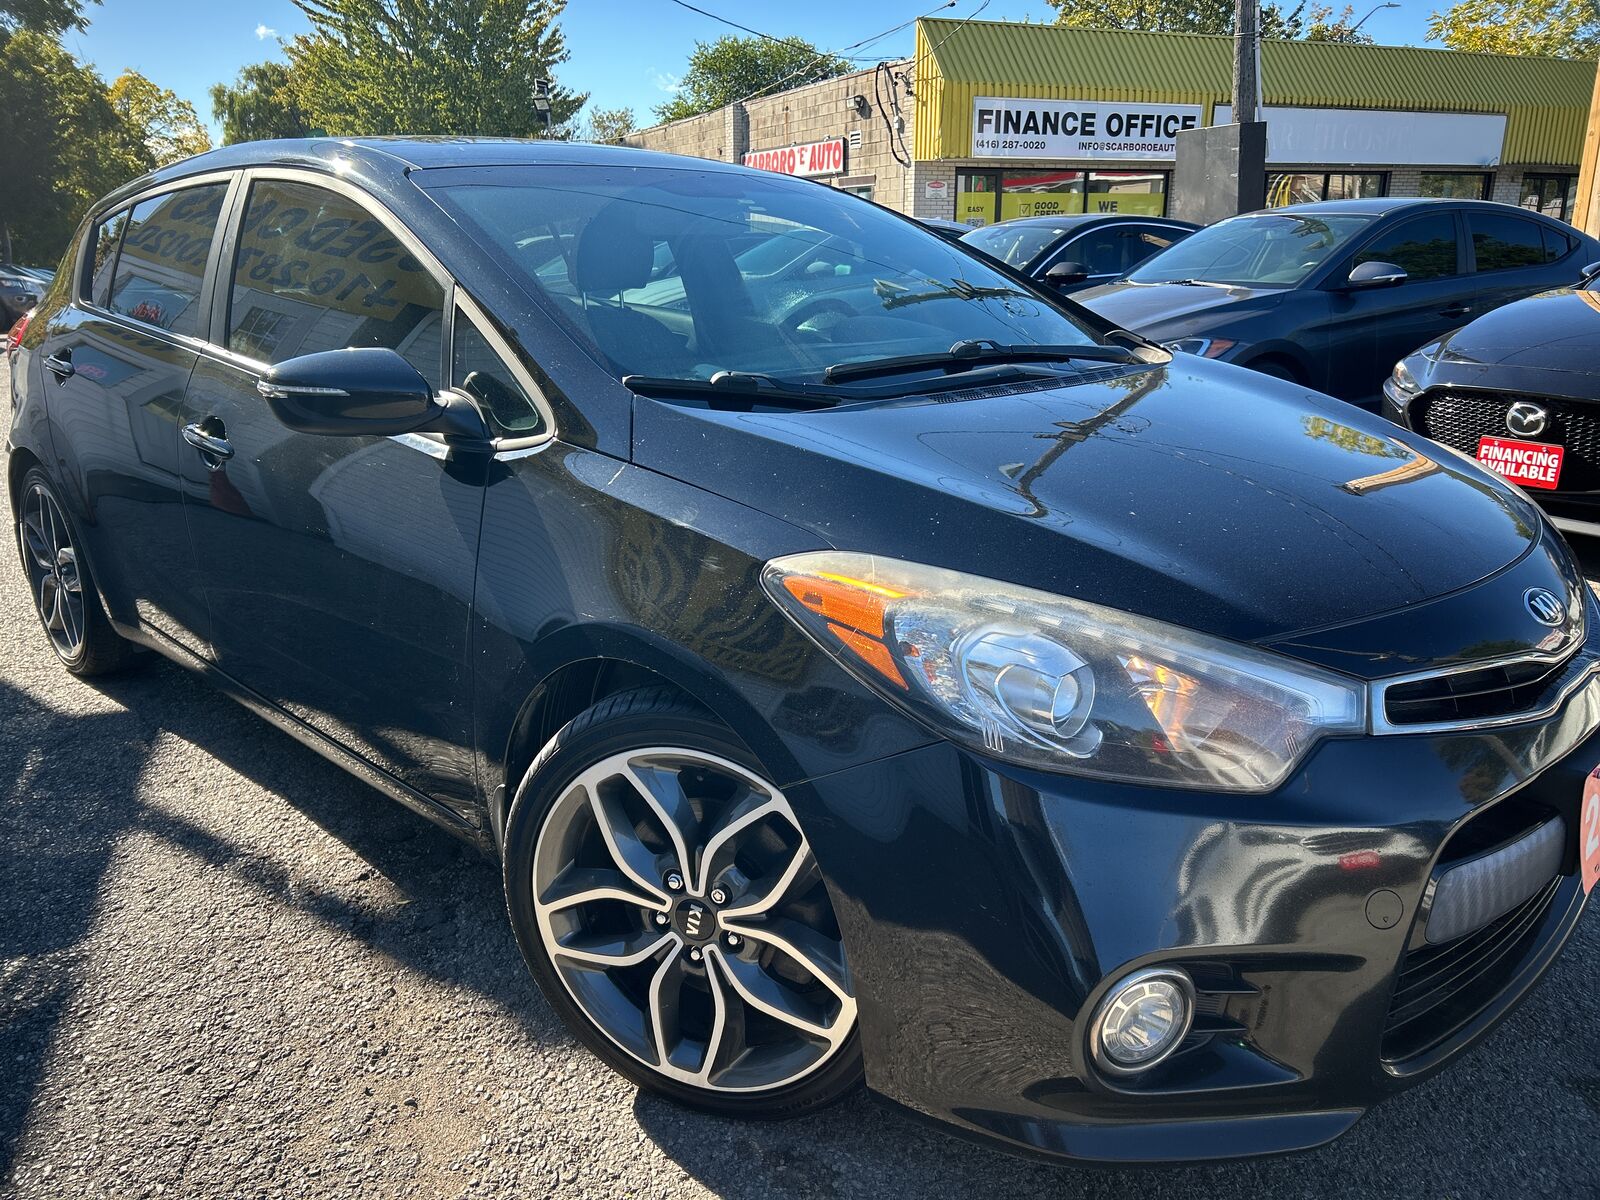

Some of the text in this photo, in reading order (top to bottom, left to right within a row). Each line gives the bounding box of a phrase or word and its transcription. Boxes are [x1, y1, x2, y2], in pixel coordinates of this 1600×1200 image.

[977, 109, 1197, 139] FINANCE OFFICE
[976, 140, 1046, 150] (416) 287-0020
[1078, 141, 1177, 152] INFO@SCARBOROEAUT
[744, 148, 796, 175] CARBORO
[809, 141, 842, 172] AUTO
[1034, 201, 1059, 210] GOOD
[1098, 201, 1118, 213] WE
[1480, 444, 1559, 468] FINANCING
[685, 903, 703, 935] KIA
